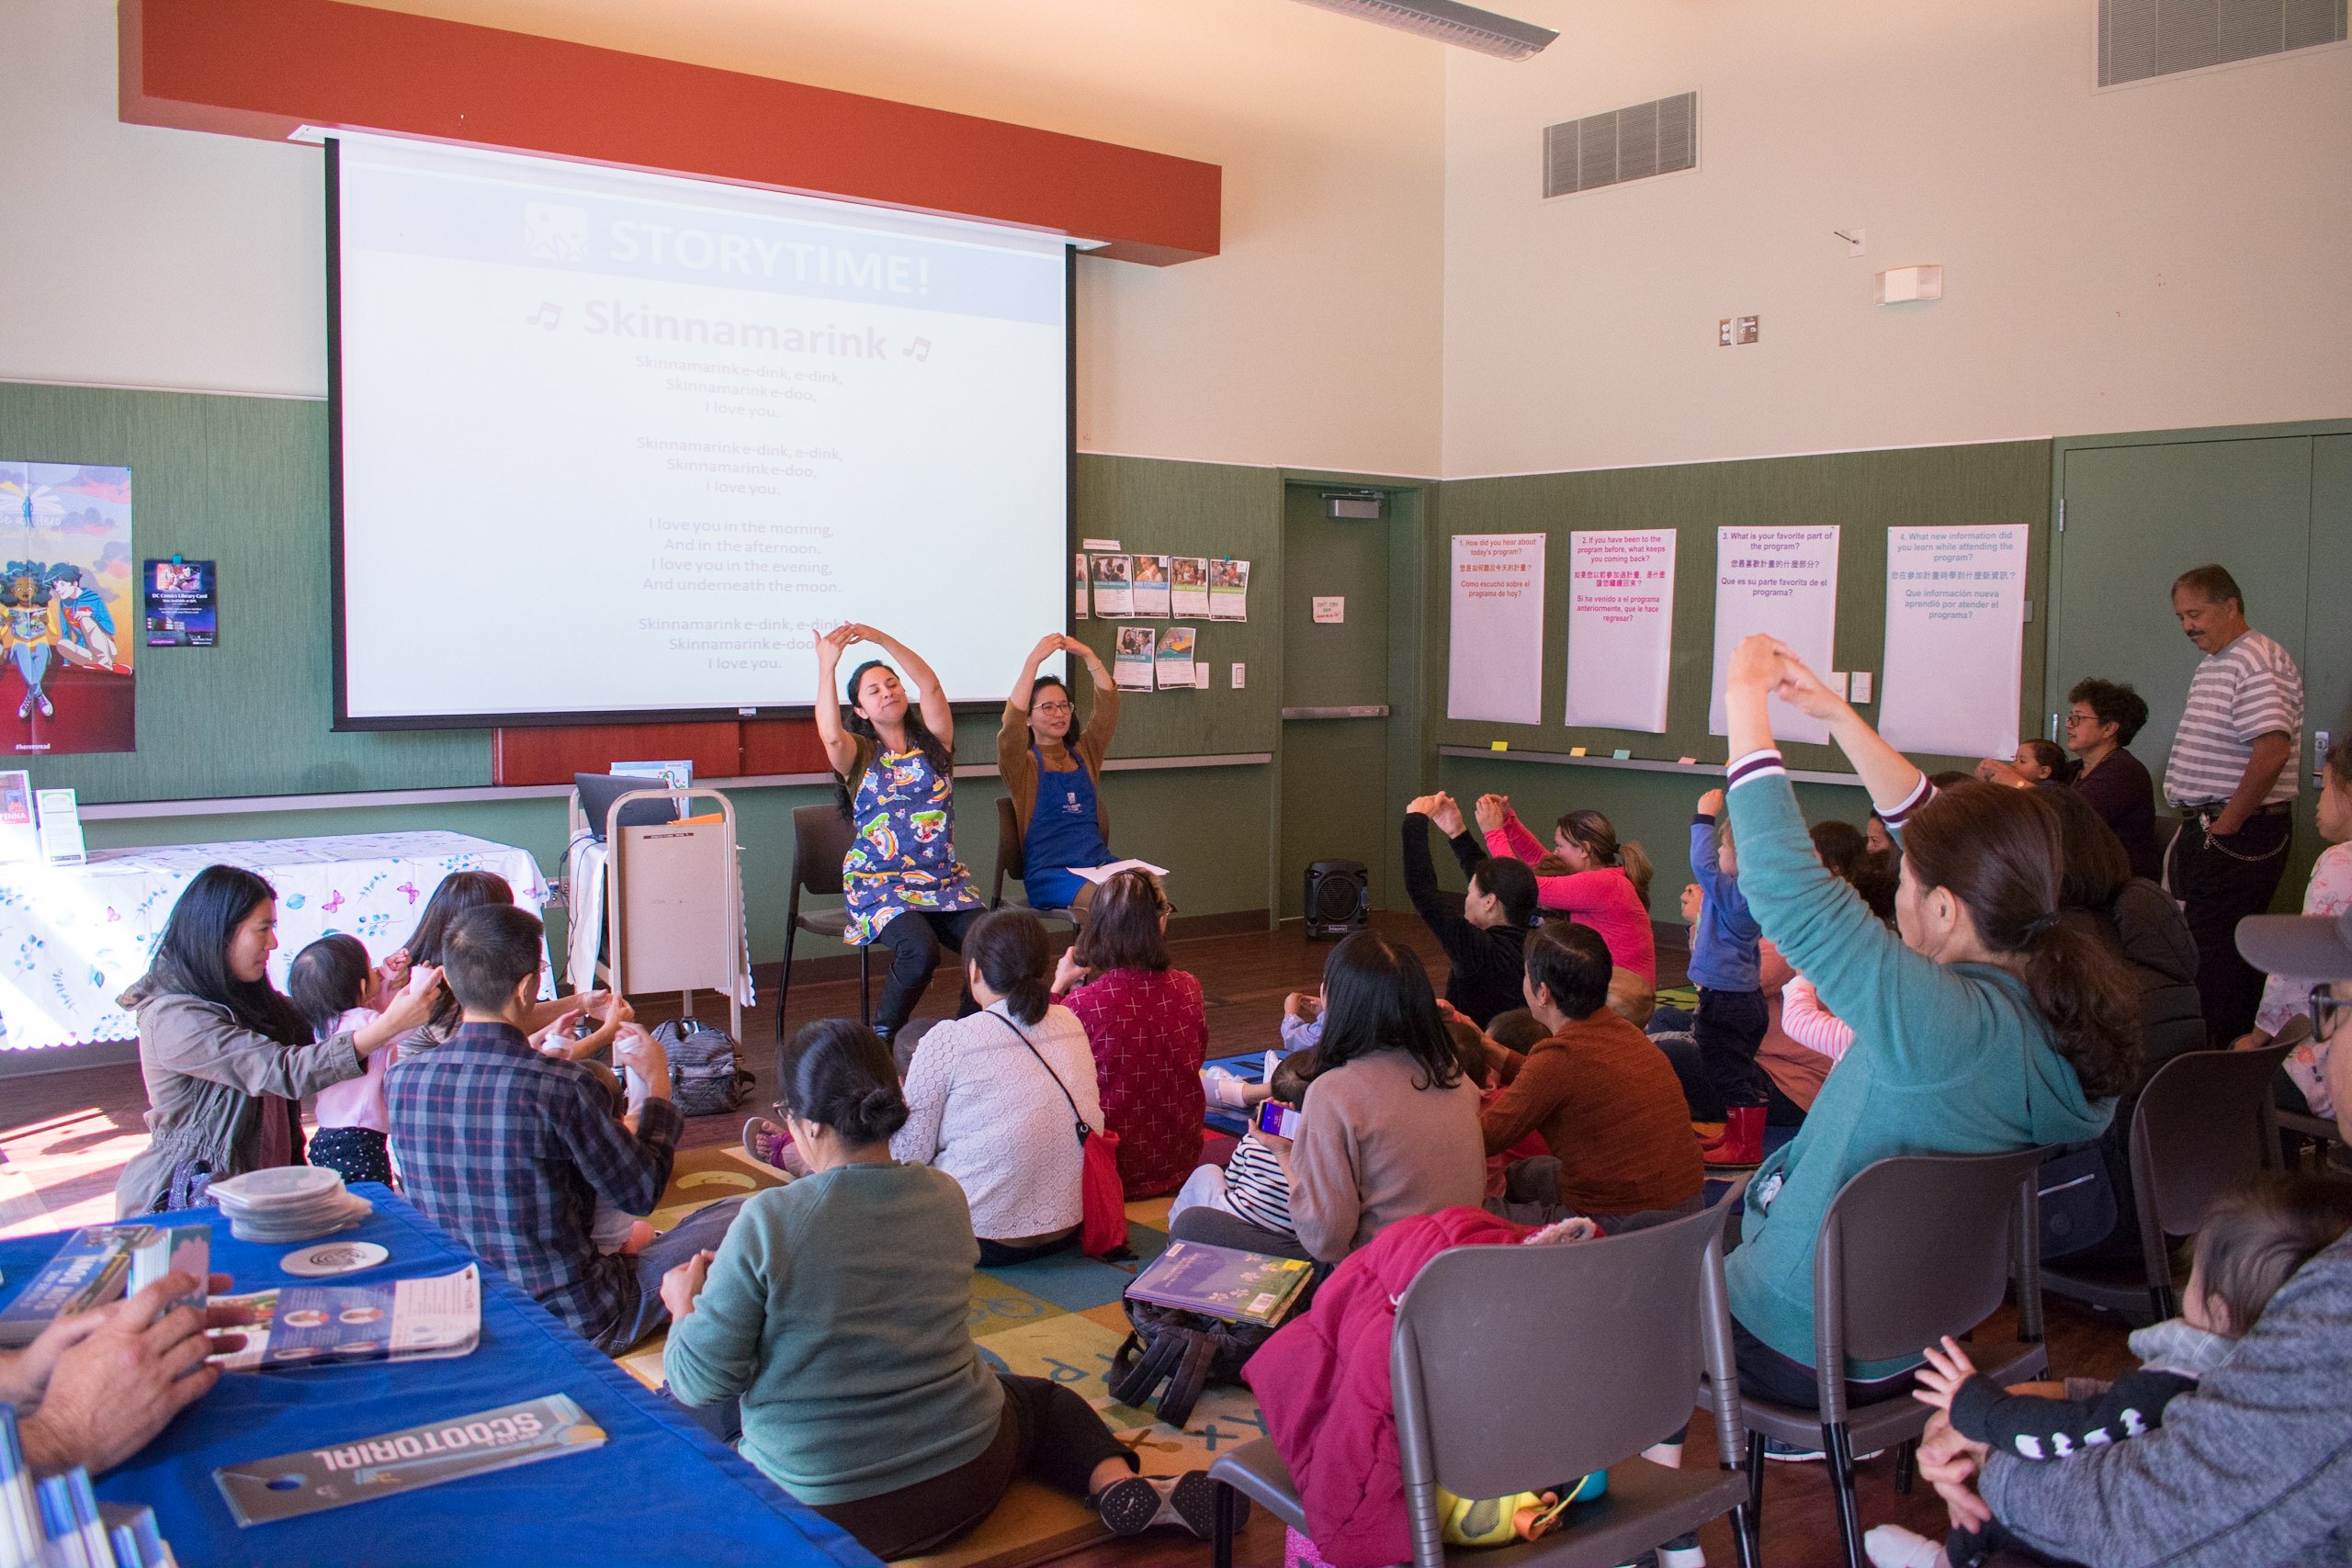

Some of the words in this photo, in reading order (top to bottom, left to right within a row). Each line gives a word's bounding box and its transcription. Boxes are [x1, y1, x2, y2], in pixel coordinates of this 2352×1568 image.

[609, 220, 929, 296] STORYTIME!
[583, 299, 888, 361] Skinnamarink
[636, 355, 740, 377] Skinnamarink
[741, 362, 792, 381] e-dink,
[795, 368, 843, 387] e-dink,
[666, 378, 769, 398] Skinnamarink
[771, 385, 817, 404] e-doo,
[713, 400, 745, 416] love
[747, 404, 780, 419] you.
[637, 436, 741, 455] Skinnamarink
[742, 443, 793, 459] e-dink,
[796, 446, 843, 463] e-dink,
[666, 457, 769, 475] Skinnamarink
[771, 463, 817, 479] e-doo,
[713, 480, 745, 493] love
[749, 483, 780, 497] you.
[657, 518, 689, 531] love
[693, 521, 721, 534] you
[724, 520, 738, 533] in
[741, 521, 766, 534] the
[769, 523, 834, 538] morning,
[1806, 533, 1822, 541] part
[663, 539, 695, 551] And
[697, 539, 712, 551] in
[717, 540, 741, 552] the
[744, 540, 821, 555] afternoon.
[1471, 548, 1491, 557] today's
[1646, 546, 1666, 554] keeps
[1763, 542, 1800, 551] program?
[1959, 543, 1997, 551] attending
[1933, 554, 1973, 562] program?
[660, 558, 692, 571] love
[695, 560, 724, 574] you
[726, 560, 740, 572] in
[744, 559, 768, 572] the
[772, 561, 832, 576] evening,
[642, 578, 673, 591] And
[677, 578, 764, 592] underneath
[768, 579, 793, 592] the
[796, 581, 842, 593] moon.
[1721, 577, 1736, 585] Que
[1780, 578, 1807, 586] favorita
[1507, 591, 1522, 599] hoy?
[1752, 589, 1793, 597] programa?
[1905, 589, 1922, 597] Que
[1905, 600, 1939, 609] aprendió
[1928, 611, 1973, 620] programa?
[639, 617, 741, 631] Skinnamarink
[744, 618, 794, 633] e-dink,
[669, 637, 770, 650] Skinnamarink
[717, 657, 747, 670] love
[751, 659, 782, 671] you.
[313, 1412, 543, 1472] SCOOTORIAL
